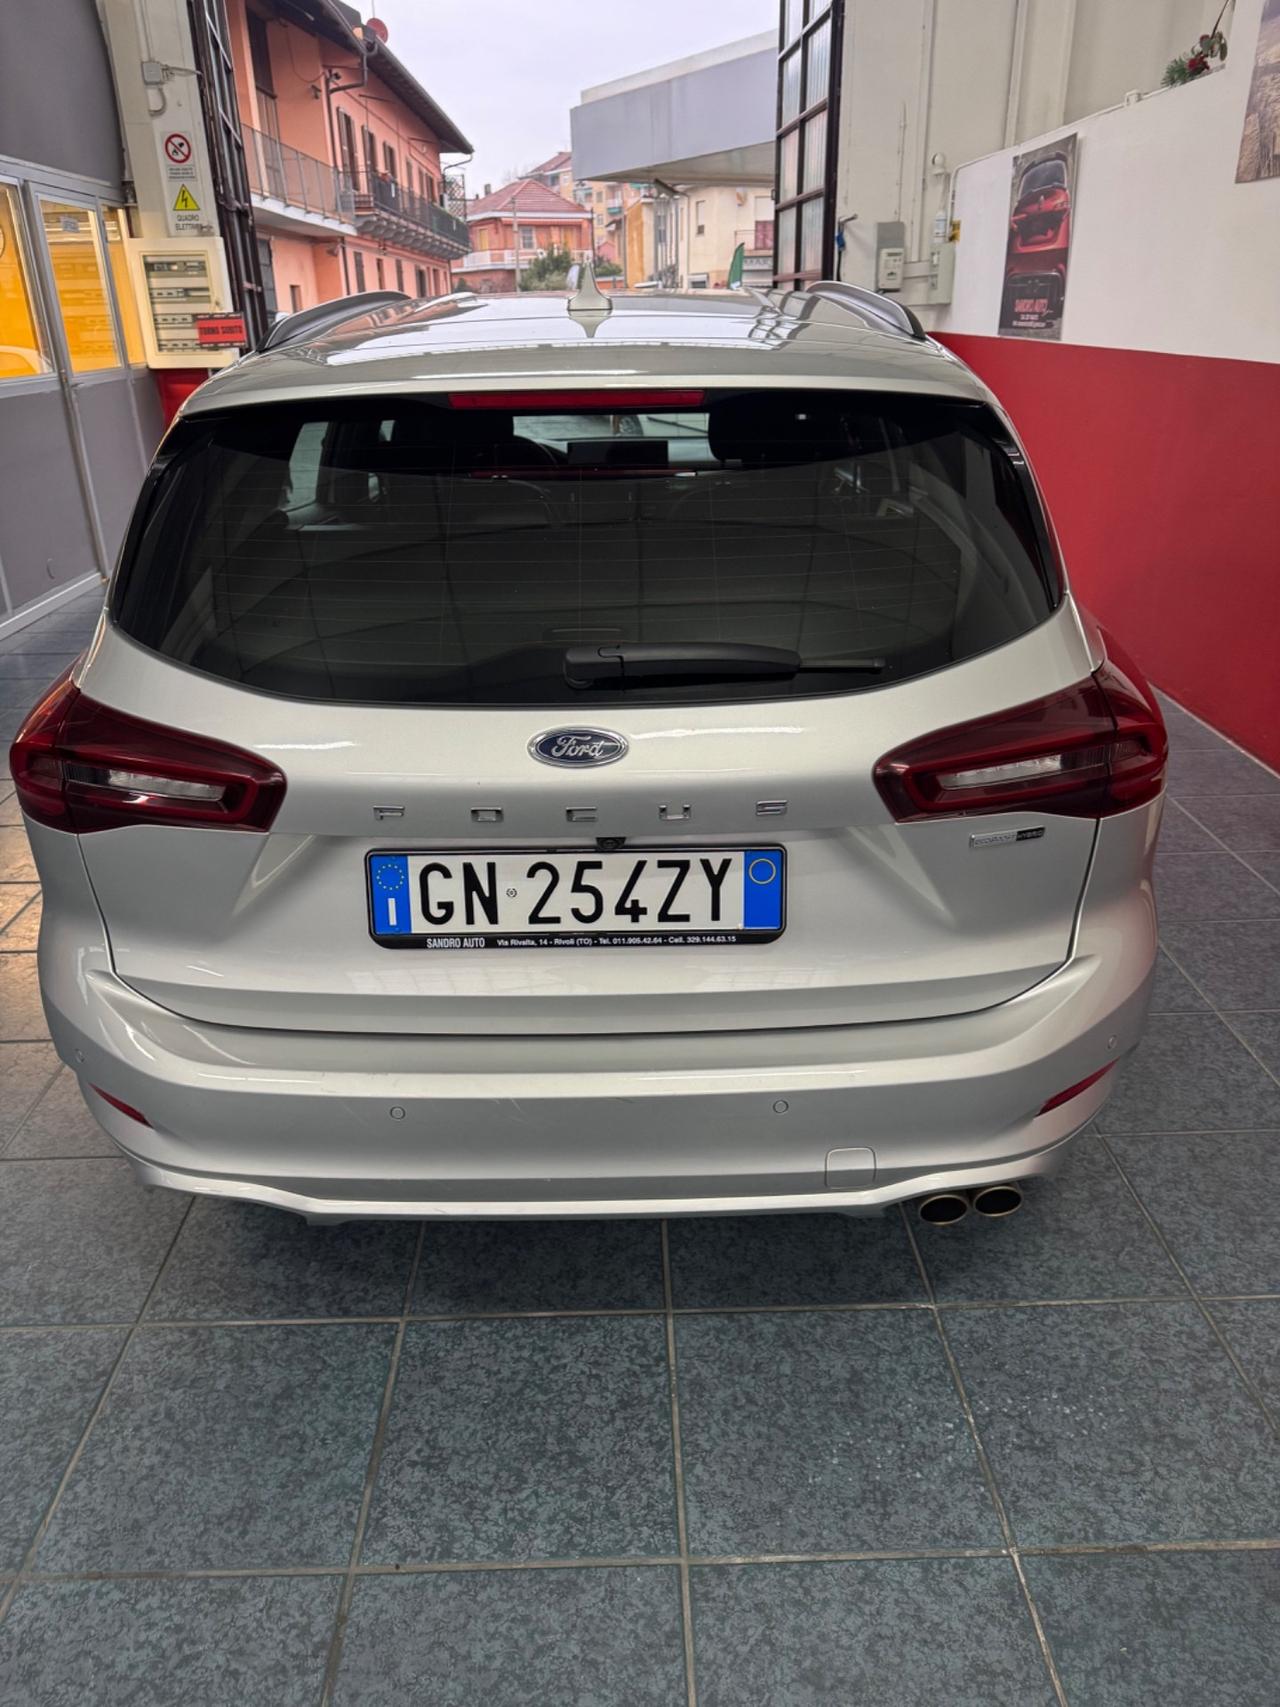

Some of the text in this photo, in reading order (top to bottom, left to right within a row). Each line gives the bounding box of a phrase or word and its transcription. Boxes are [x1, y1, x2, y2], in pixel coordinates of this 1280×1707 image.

[177, 214, 199, 222] QUADRO
[551, 735, 605, 759] Ford
[373, 799, 788, 823] FOCUS
[387, 857, 734, 926] I GN 254ZY
[426, 937, 461, 949] SANDRO
[463, 937, 485, 948] AUTO
[496, 938, 509, 946] Via
[576, 937, 592, 946] (TO)
